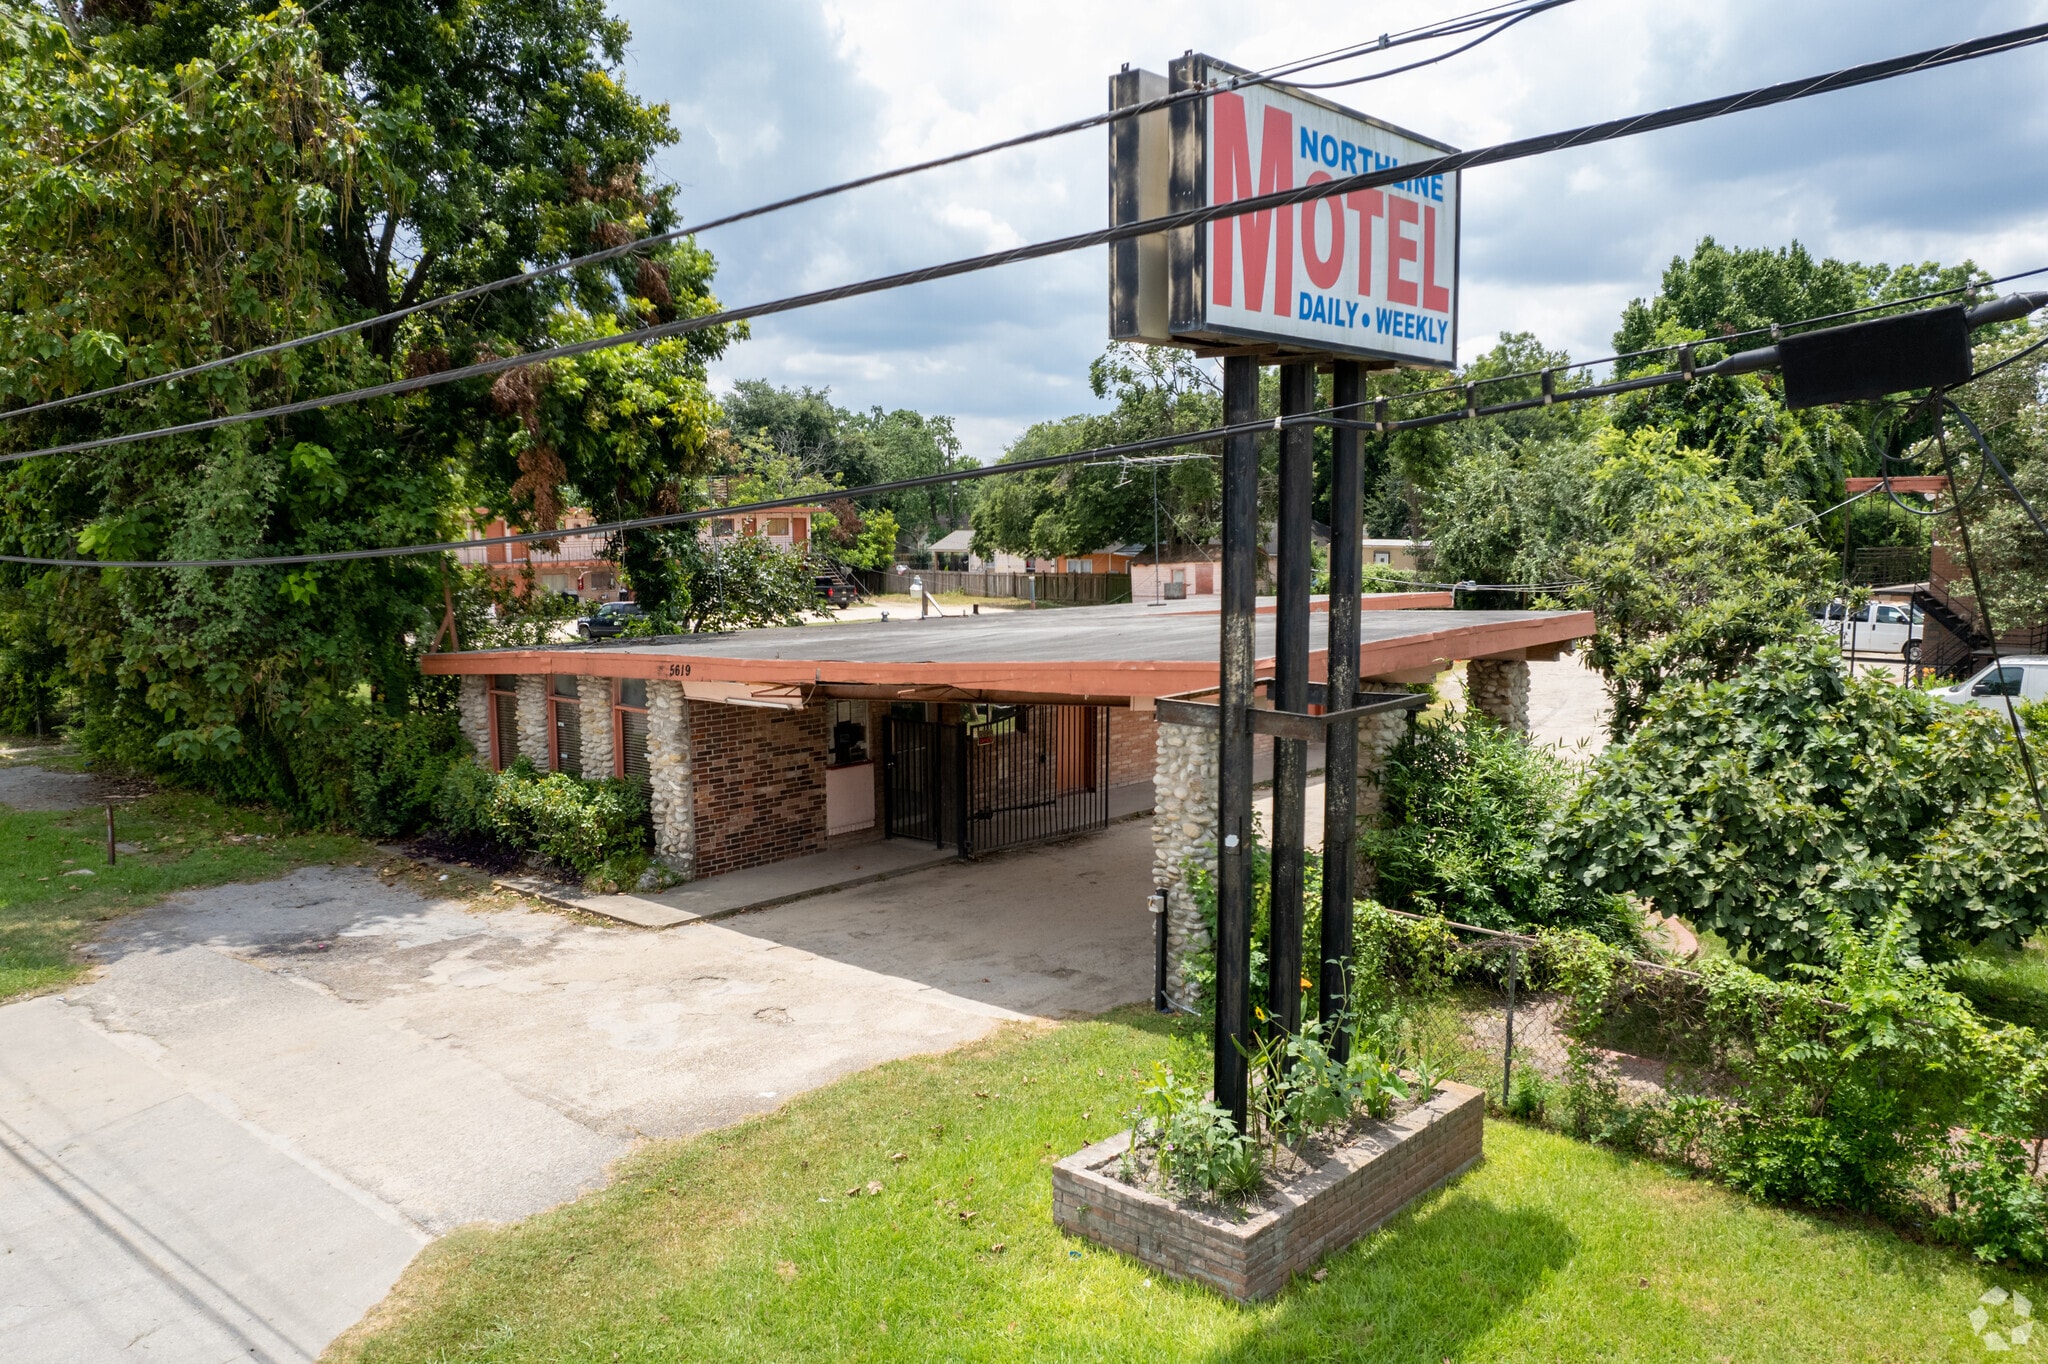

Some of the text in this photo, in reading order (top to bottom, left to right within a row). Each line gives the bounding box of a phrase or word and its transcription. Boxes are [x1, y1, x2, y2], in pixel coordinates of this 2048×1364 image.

[1213, 86, 1449, 318] MOTEL
[1299, 291, 1448, 344] DAILY WEEKLY
[669, 664, 691, 677] 5619
